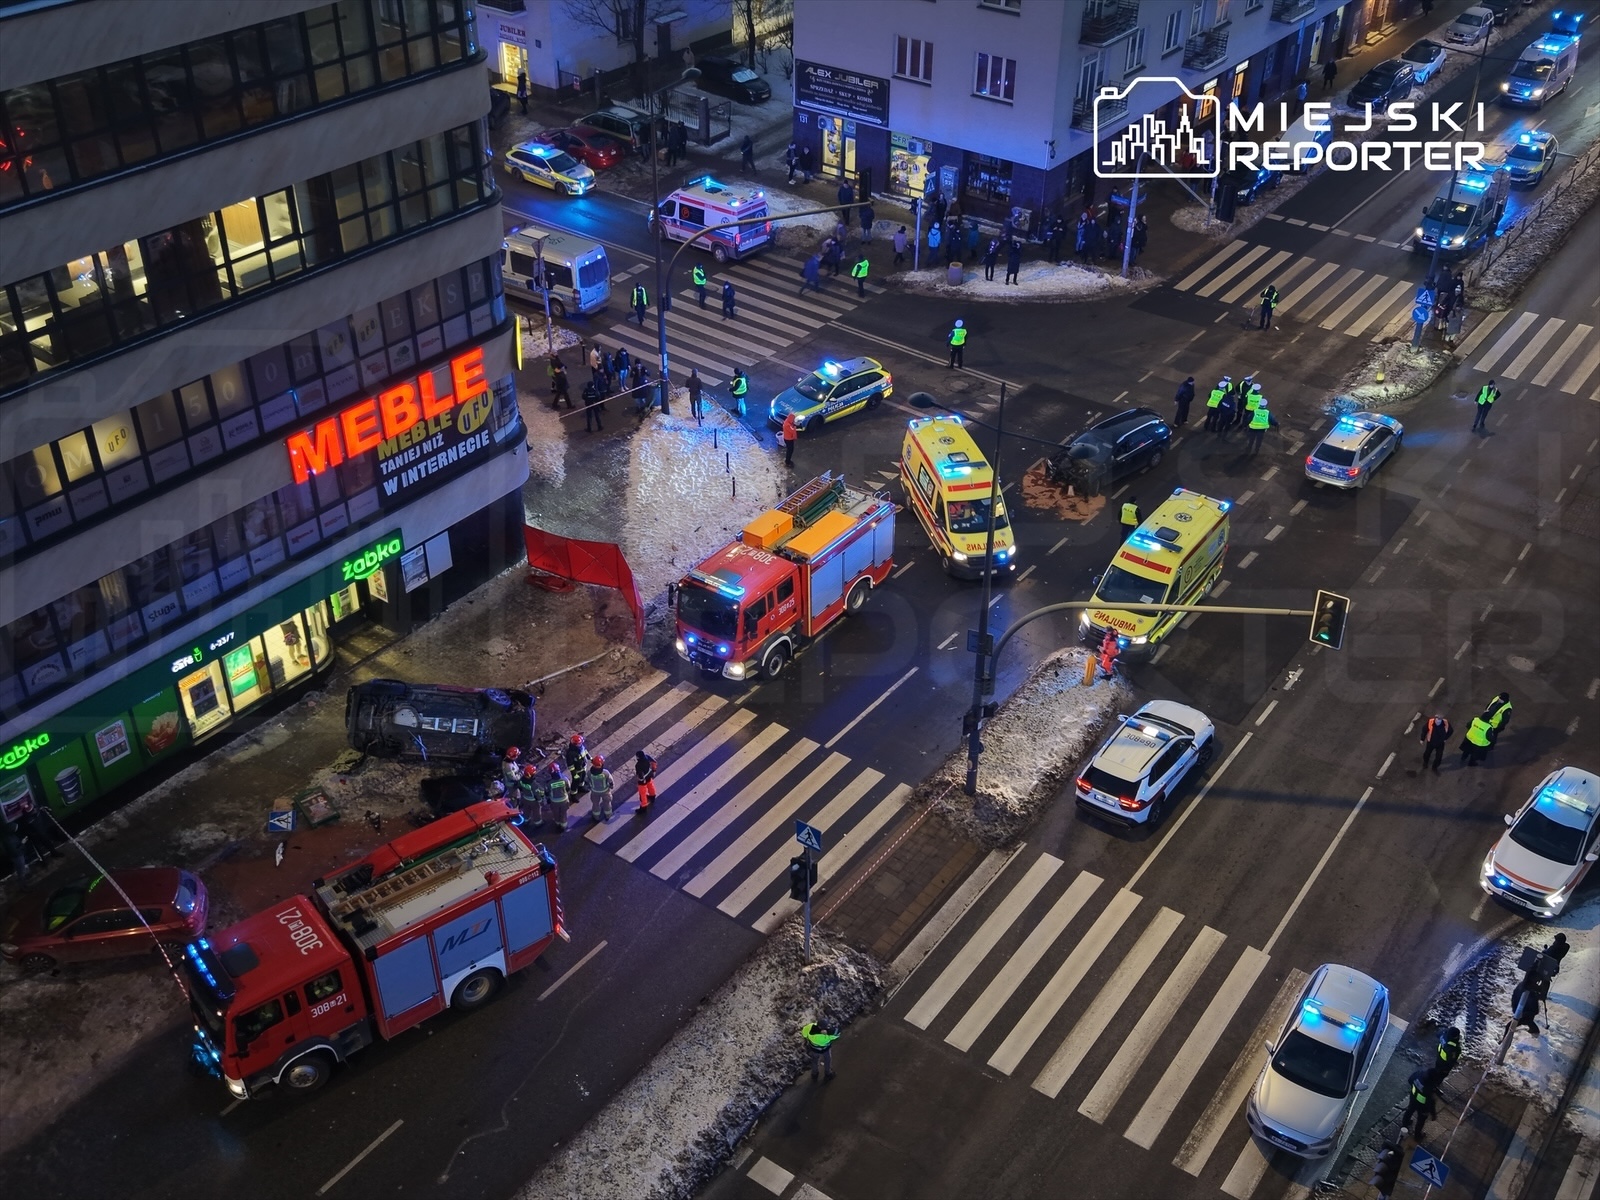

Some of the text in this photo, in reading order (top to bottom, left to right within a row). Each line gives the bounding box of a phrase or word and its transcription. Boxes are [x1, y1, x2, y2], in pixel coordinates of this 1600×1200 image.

[805, 66, 832, 79] ALEX
[834, 73, 879, 90] JUBILER
[286, 346, 488, 485] MEBLE
[377, 394, 491, 461] MEBLE UFO
[827, 402, 845, 412] POLICJA
[107, 428, 127, 453] UFO
[380, 432, 444, 476] TANIEJ NIŻ
[383, 429, 490, 497] W INTERNECIE
[341, 538, 402, 581] żabka
[209, 631, 235, 651] 6-23/7
